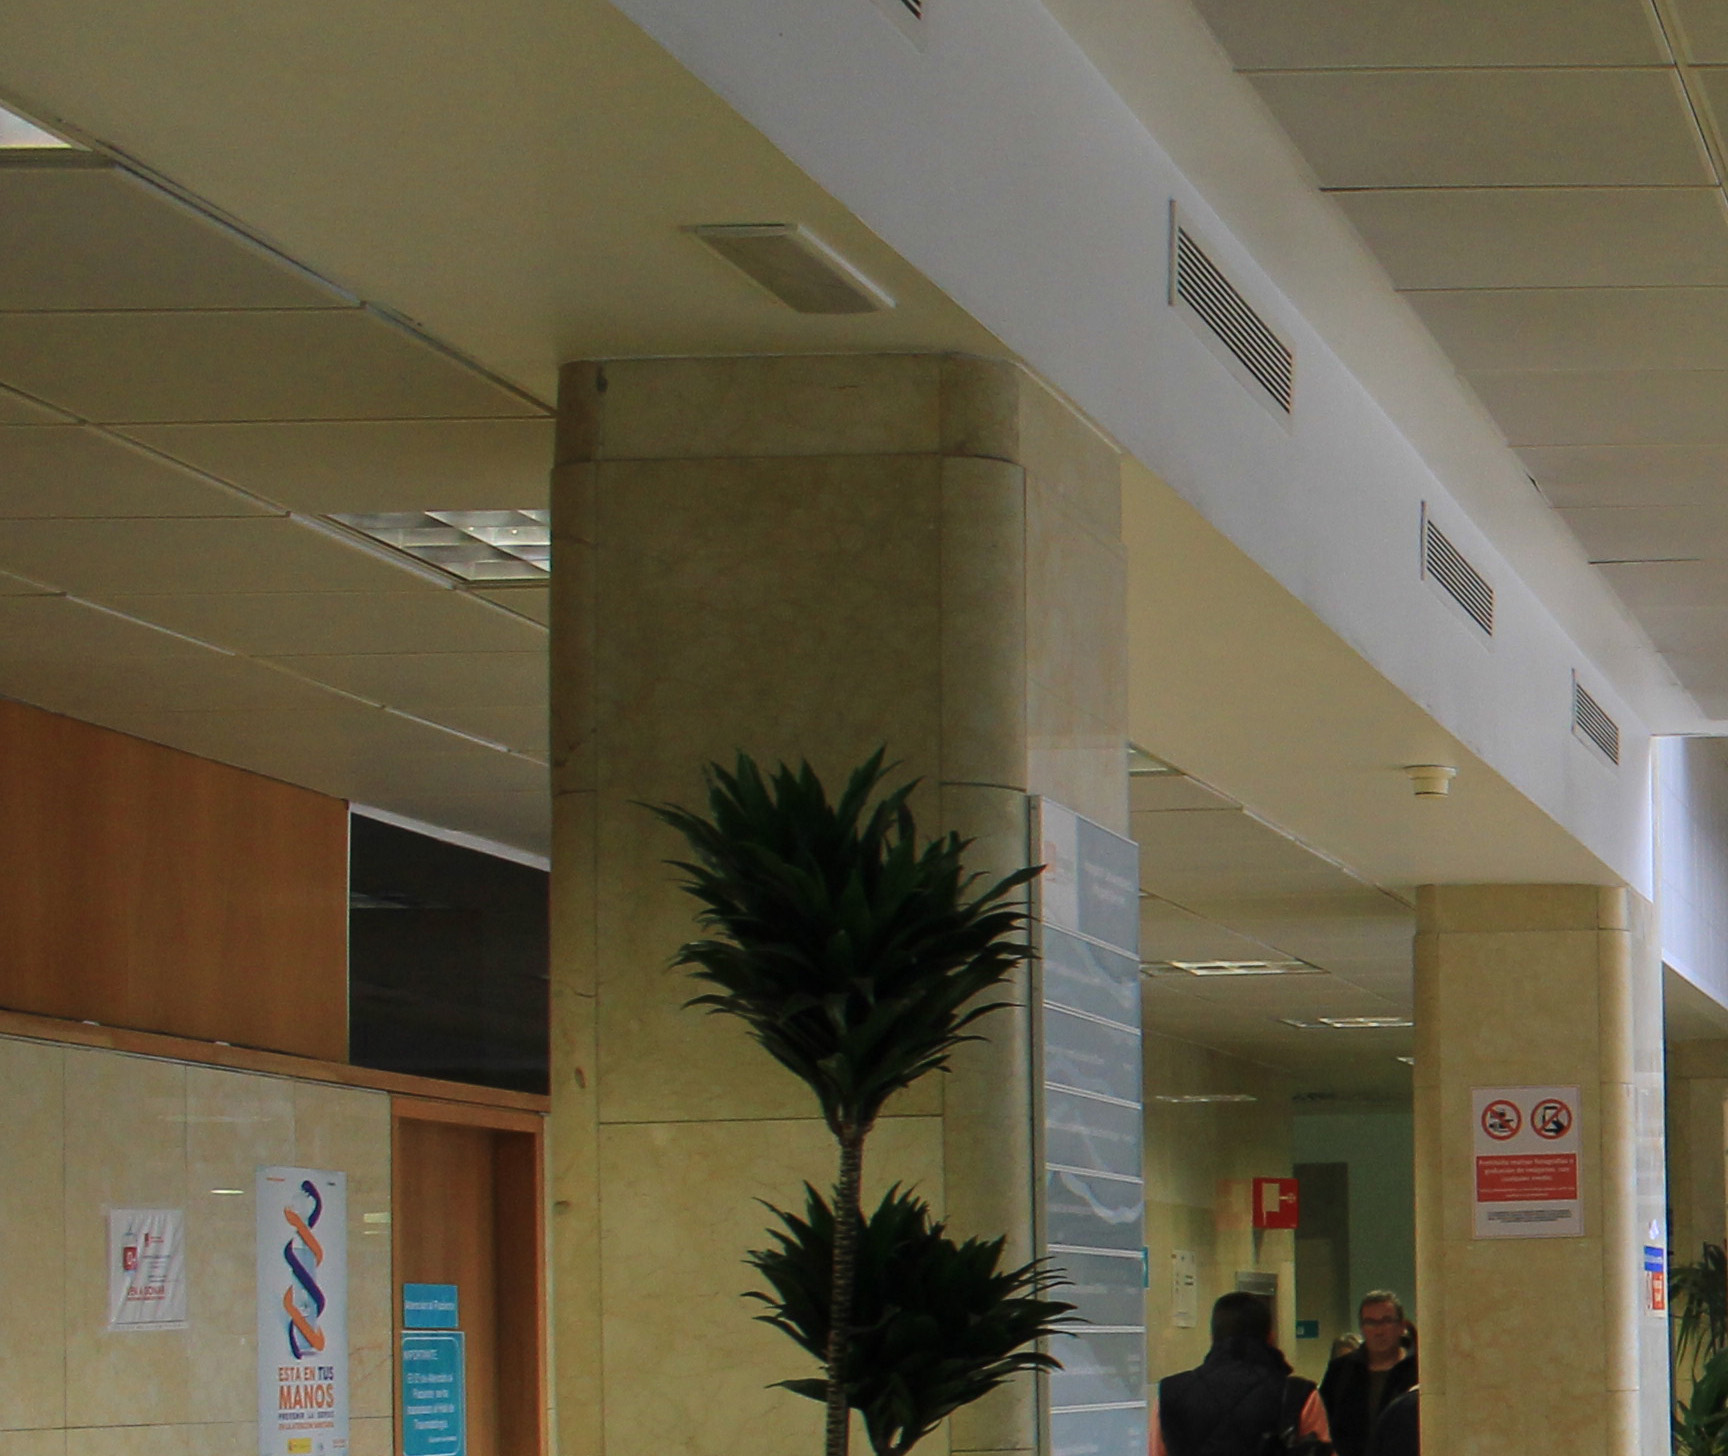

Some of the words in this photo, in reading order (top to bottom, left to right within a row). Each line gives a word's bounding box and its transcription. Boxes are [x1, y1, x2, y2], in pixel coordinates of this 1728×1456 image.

[278, 1366, 301, 1382] ESTA
[304, 1366, 315, 1381] EN
[318, 1366, 334, 1381] TUS
[278, 1383, 334, 1410] MANOS
